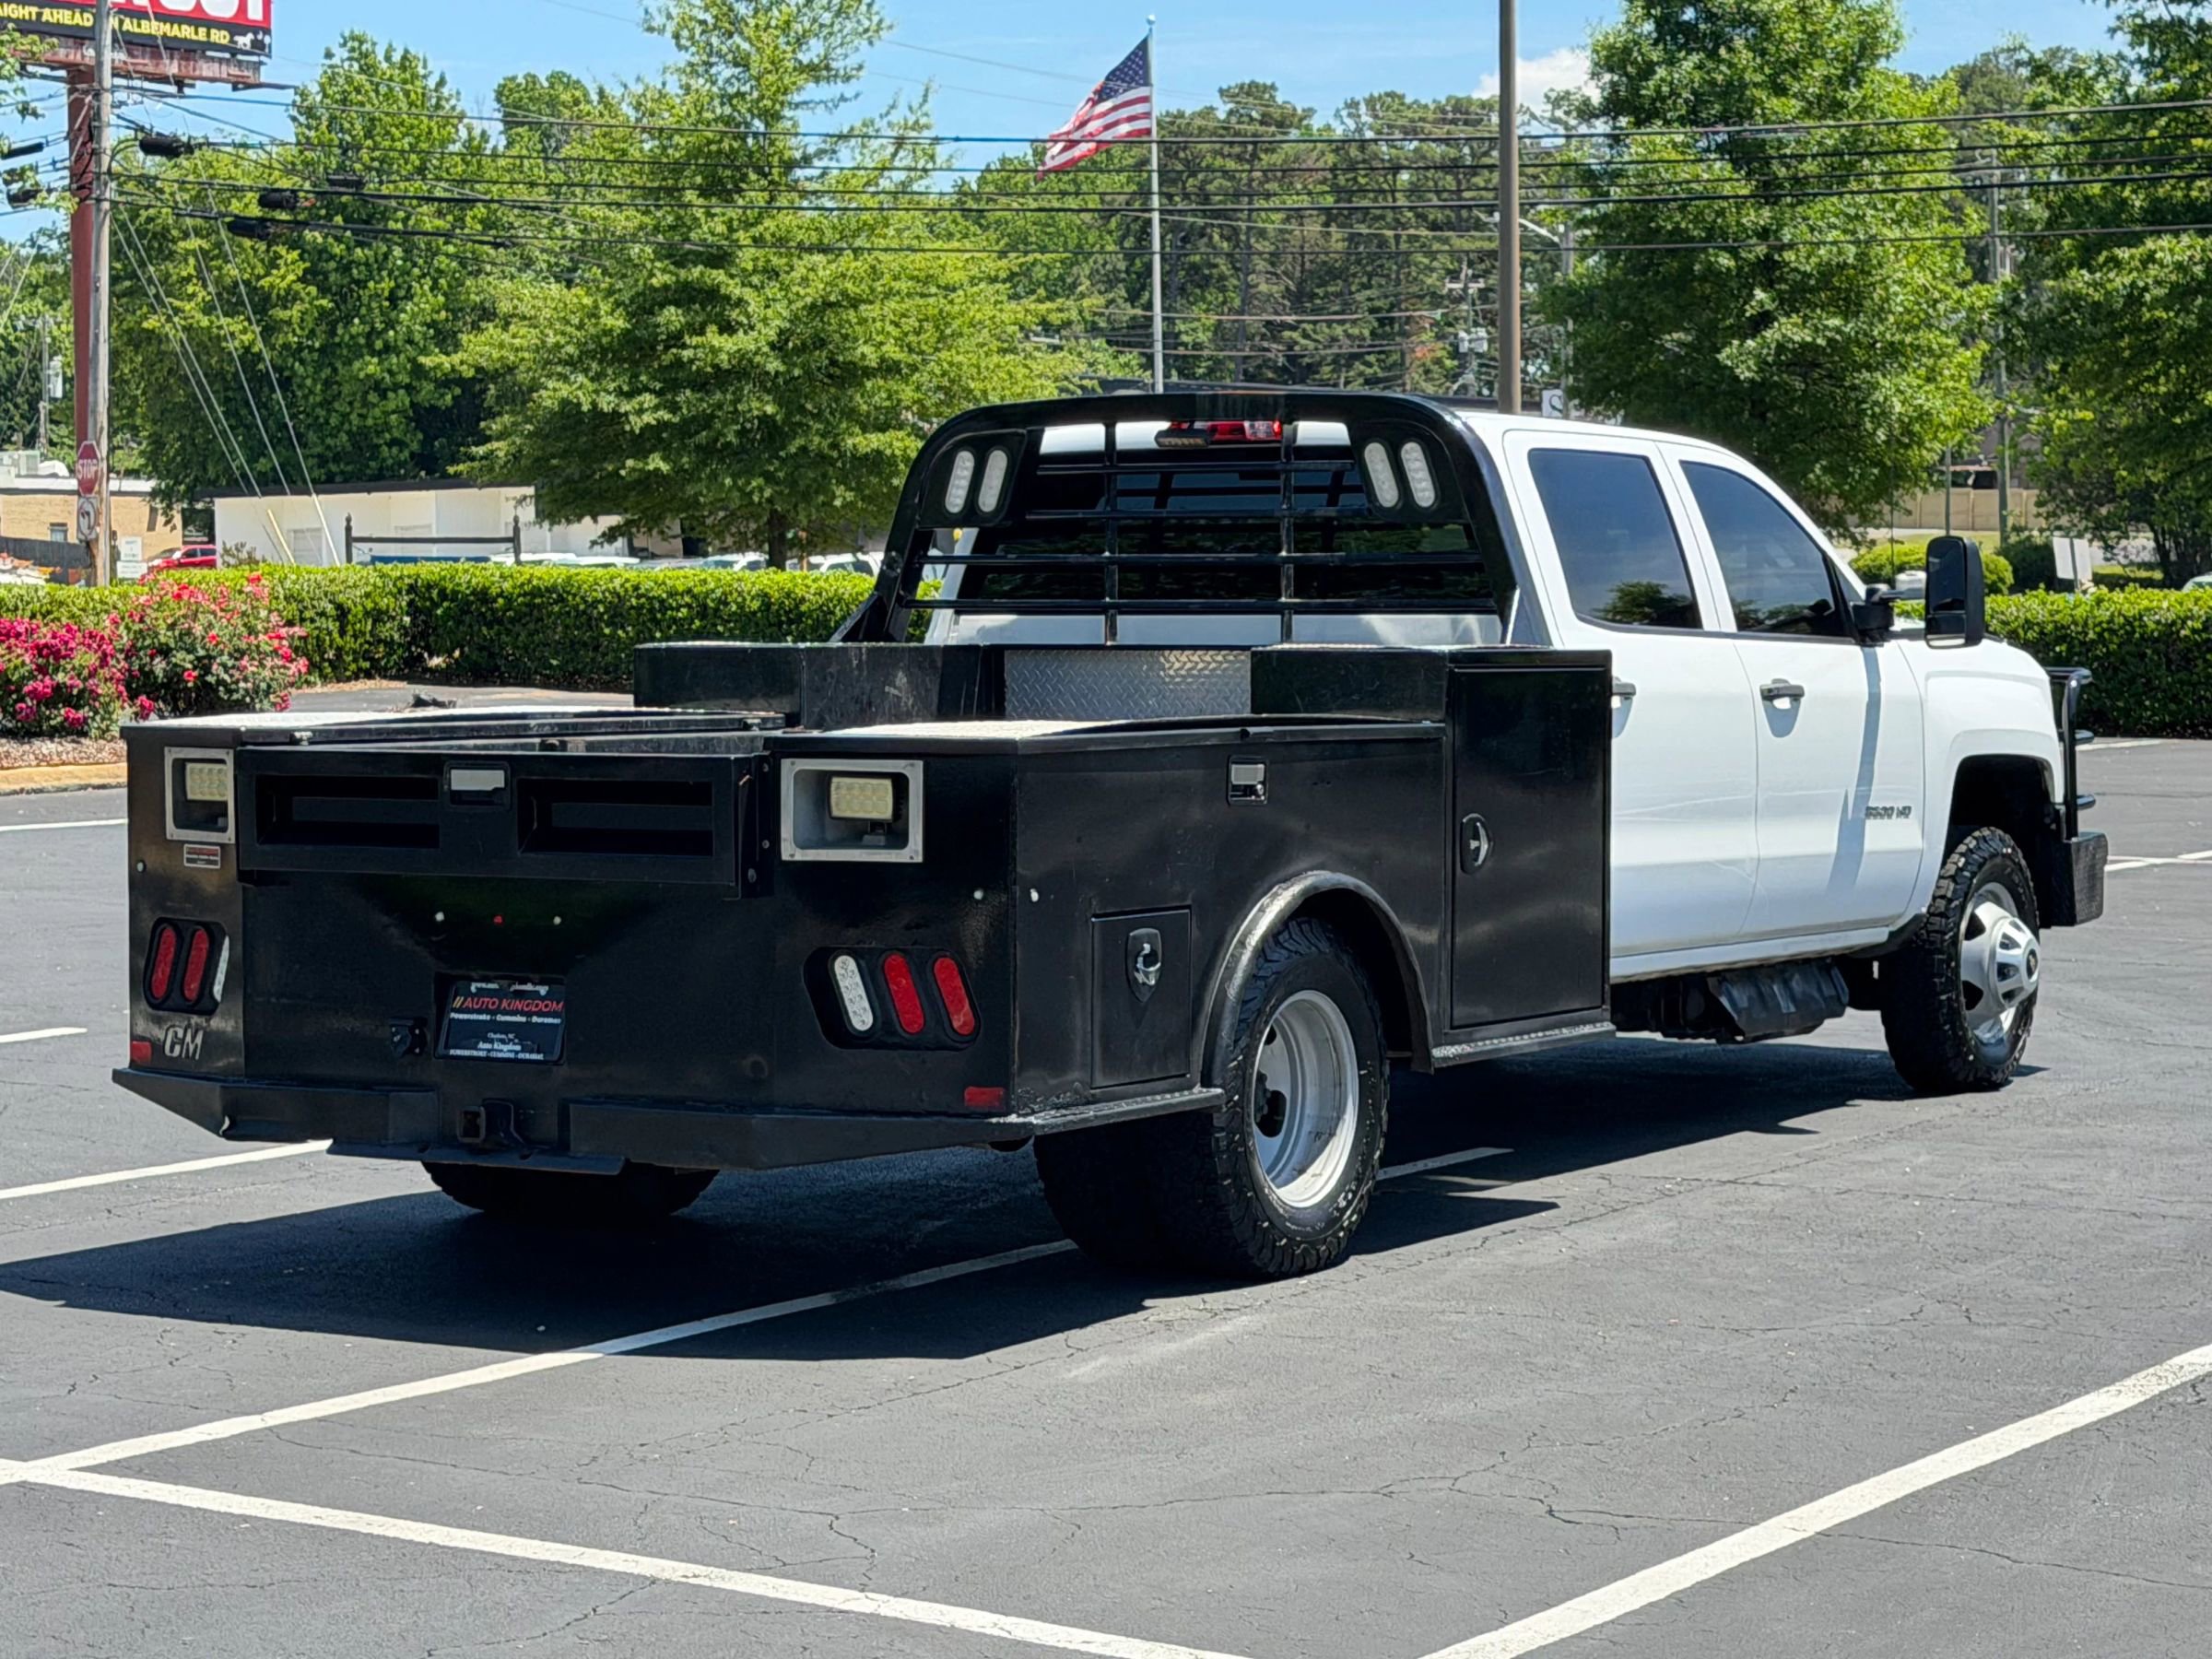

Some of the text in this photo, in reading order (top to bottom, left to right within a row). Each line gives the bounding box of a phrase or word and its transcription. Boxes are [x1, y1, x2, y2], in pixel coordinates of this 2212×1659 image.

[41, 7, 93, 27] AHEAD
[123, 18, 206, 41] ALBEMARLE
[209, 29, 229, 44] RD
[77, 459, 99, 479] STOP
[463, 997, 564, 1012] AUTO KINGDOM
[164, 1026, 204, 1061] CM
